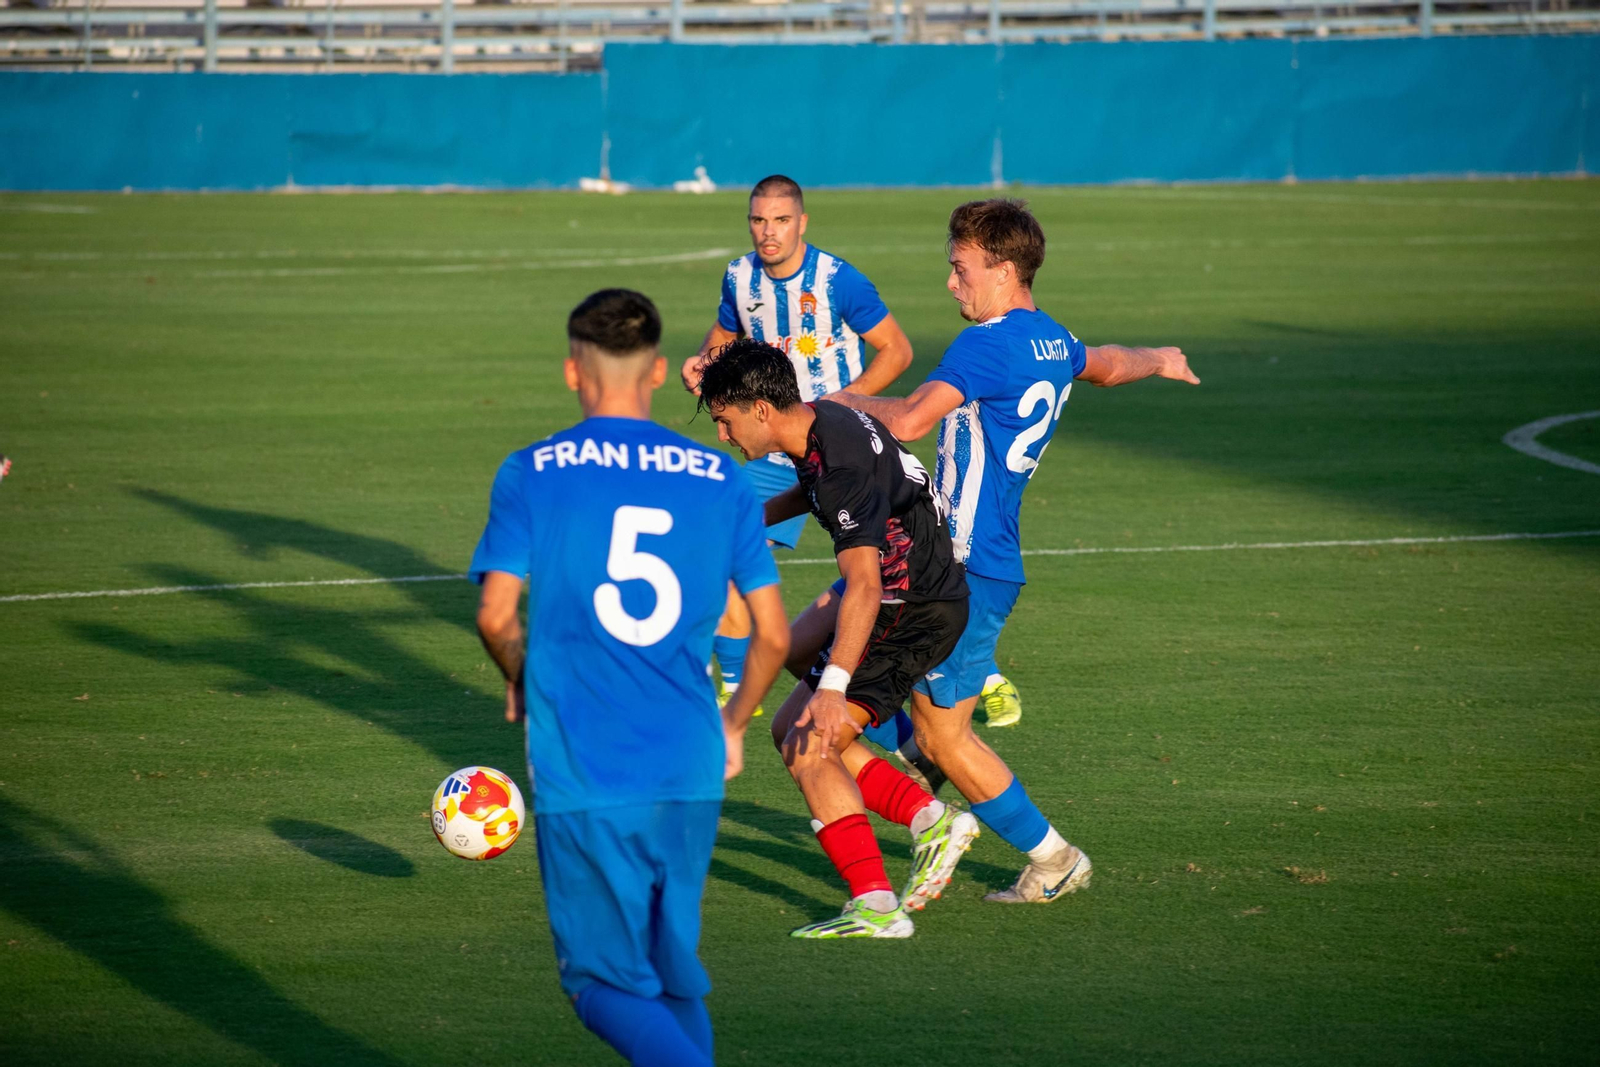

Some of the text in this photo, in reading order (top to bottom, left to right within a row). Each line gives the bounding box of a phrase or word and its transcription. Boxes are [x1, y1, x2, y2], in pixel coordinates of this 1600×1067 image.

[533, 438, 726, 481] FRAN HDEZ
[593, 504, 683, 647] 5
